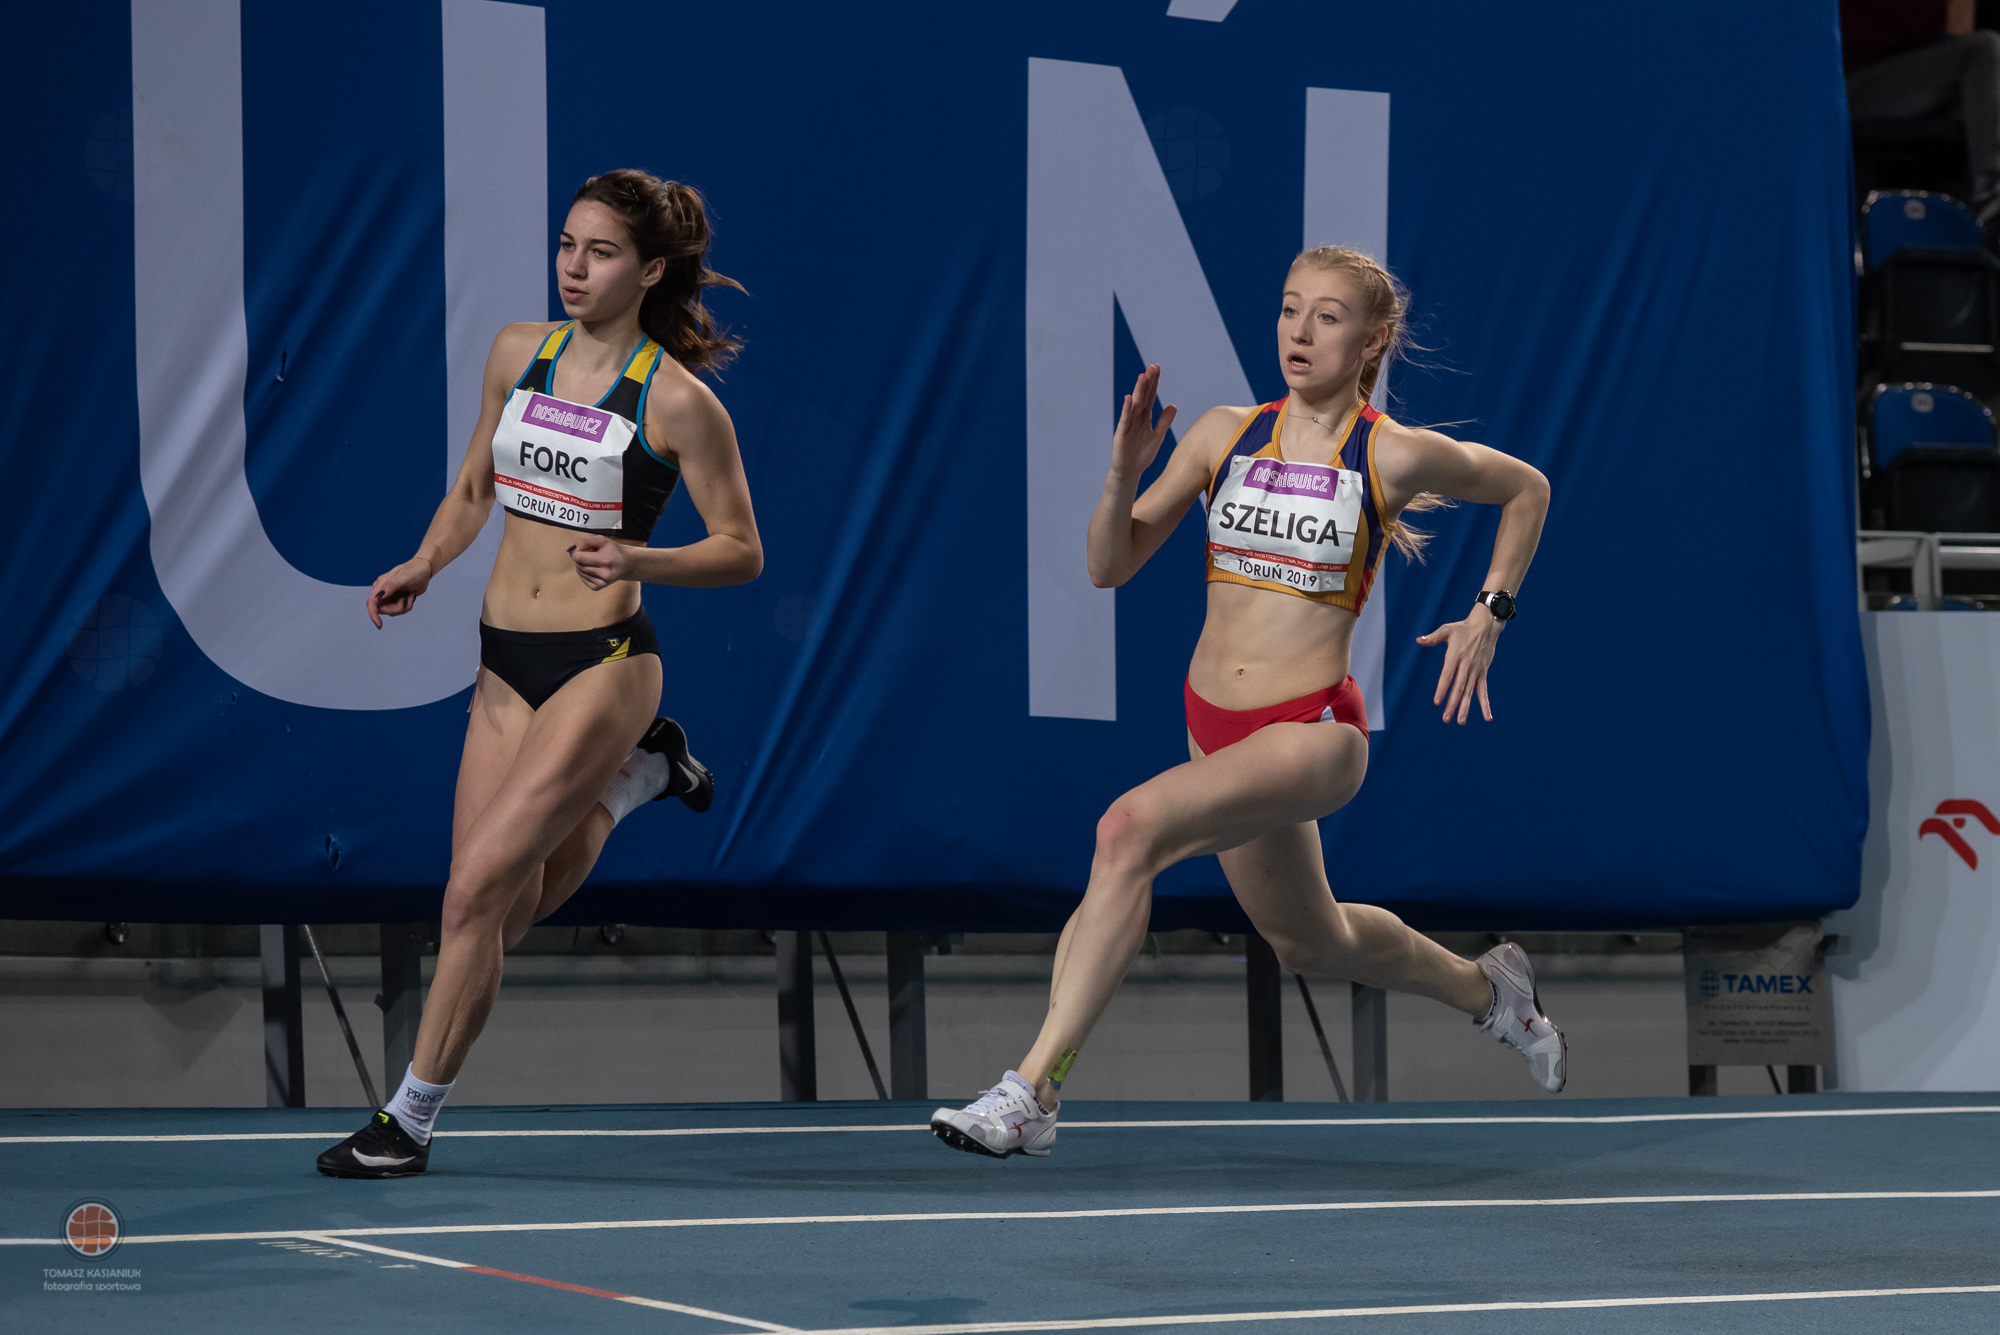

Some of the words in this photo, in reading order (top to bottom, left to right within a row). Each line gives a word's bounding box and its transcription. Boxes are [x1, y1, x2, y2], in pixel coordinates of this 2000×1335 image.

[530, 403, 603, 435] noskiewicz
[520, 440, 589, 483] FORC
[533, 486, 571, 502] MISTRZOSTWA
[1252, 466, 1331, 493] noskiewicz
[516, 493, 557, 517] TORUŃ
[558, 507, 590, 525] 2019
[1219, 501, 1341, 547] SZELIGA
[1237, 558, 1282, 580] TORUŃ
[1286, 569, 1318, 588] 2019
[1723, 974, 1813, 994] TAMEX
